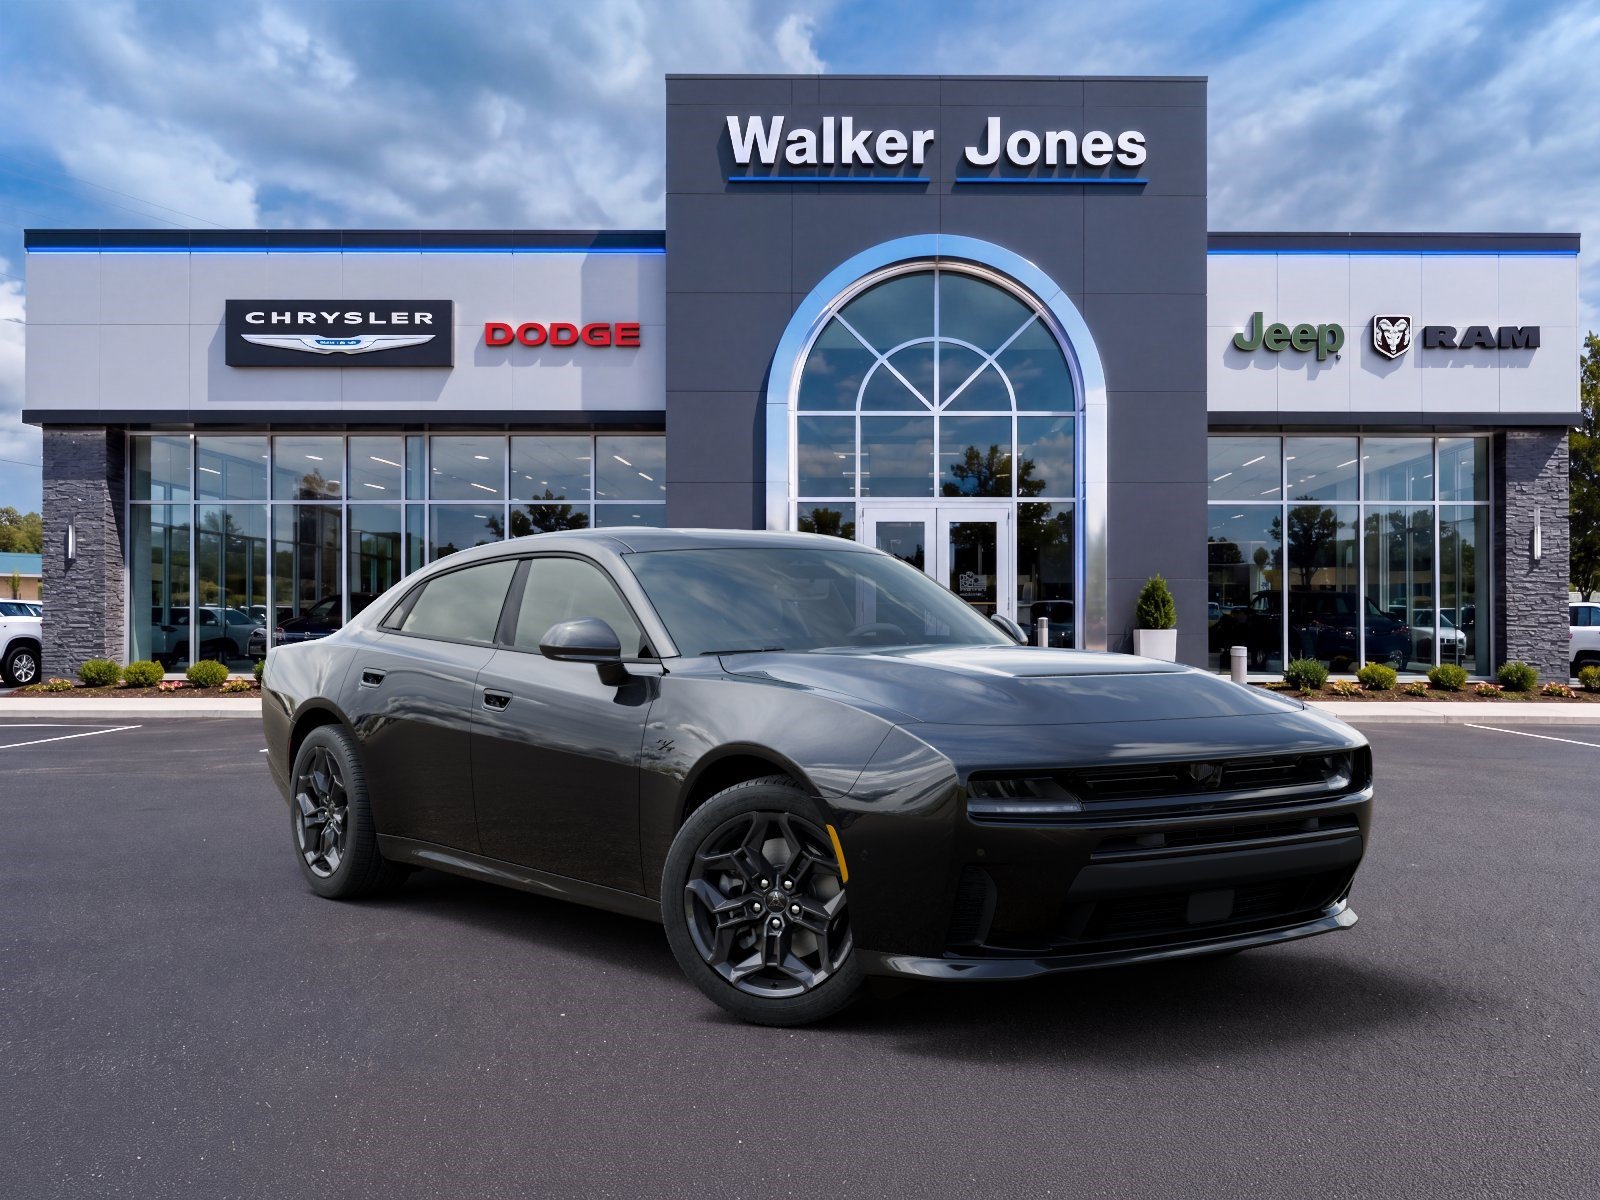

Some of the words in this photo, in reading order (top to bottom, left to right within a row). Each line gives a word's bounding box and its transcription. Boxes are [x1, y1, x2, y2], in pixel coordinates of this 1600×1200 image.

[726, 115, 935, 166] Walker
[964, 115, 1148, 167] Jones
[245, 311, 433, 324] CHRYSLER
[485, 322, 640, 347] DODGE
[1233, 311, 1345, 361] Jeep
[1423, 325, 1541, 348] RAM
